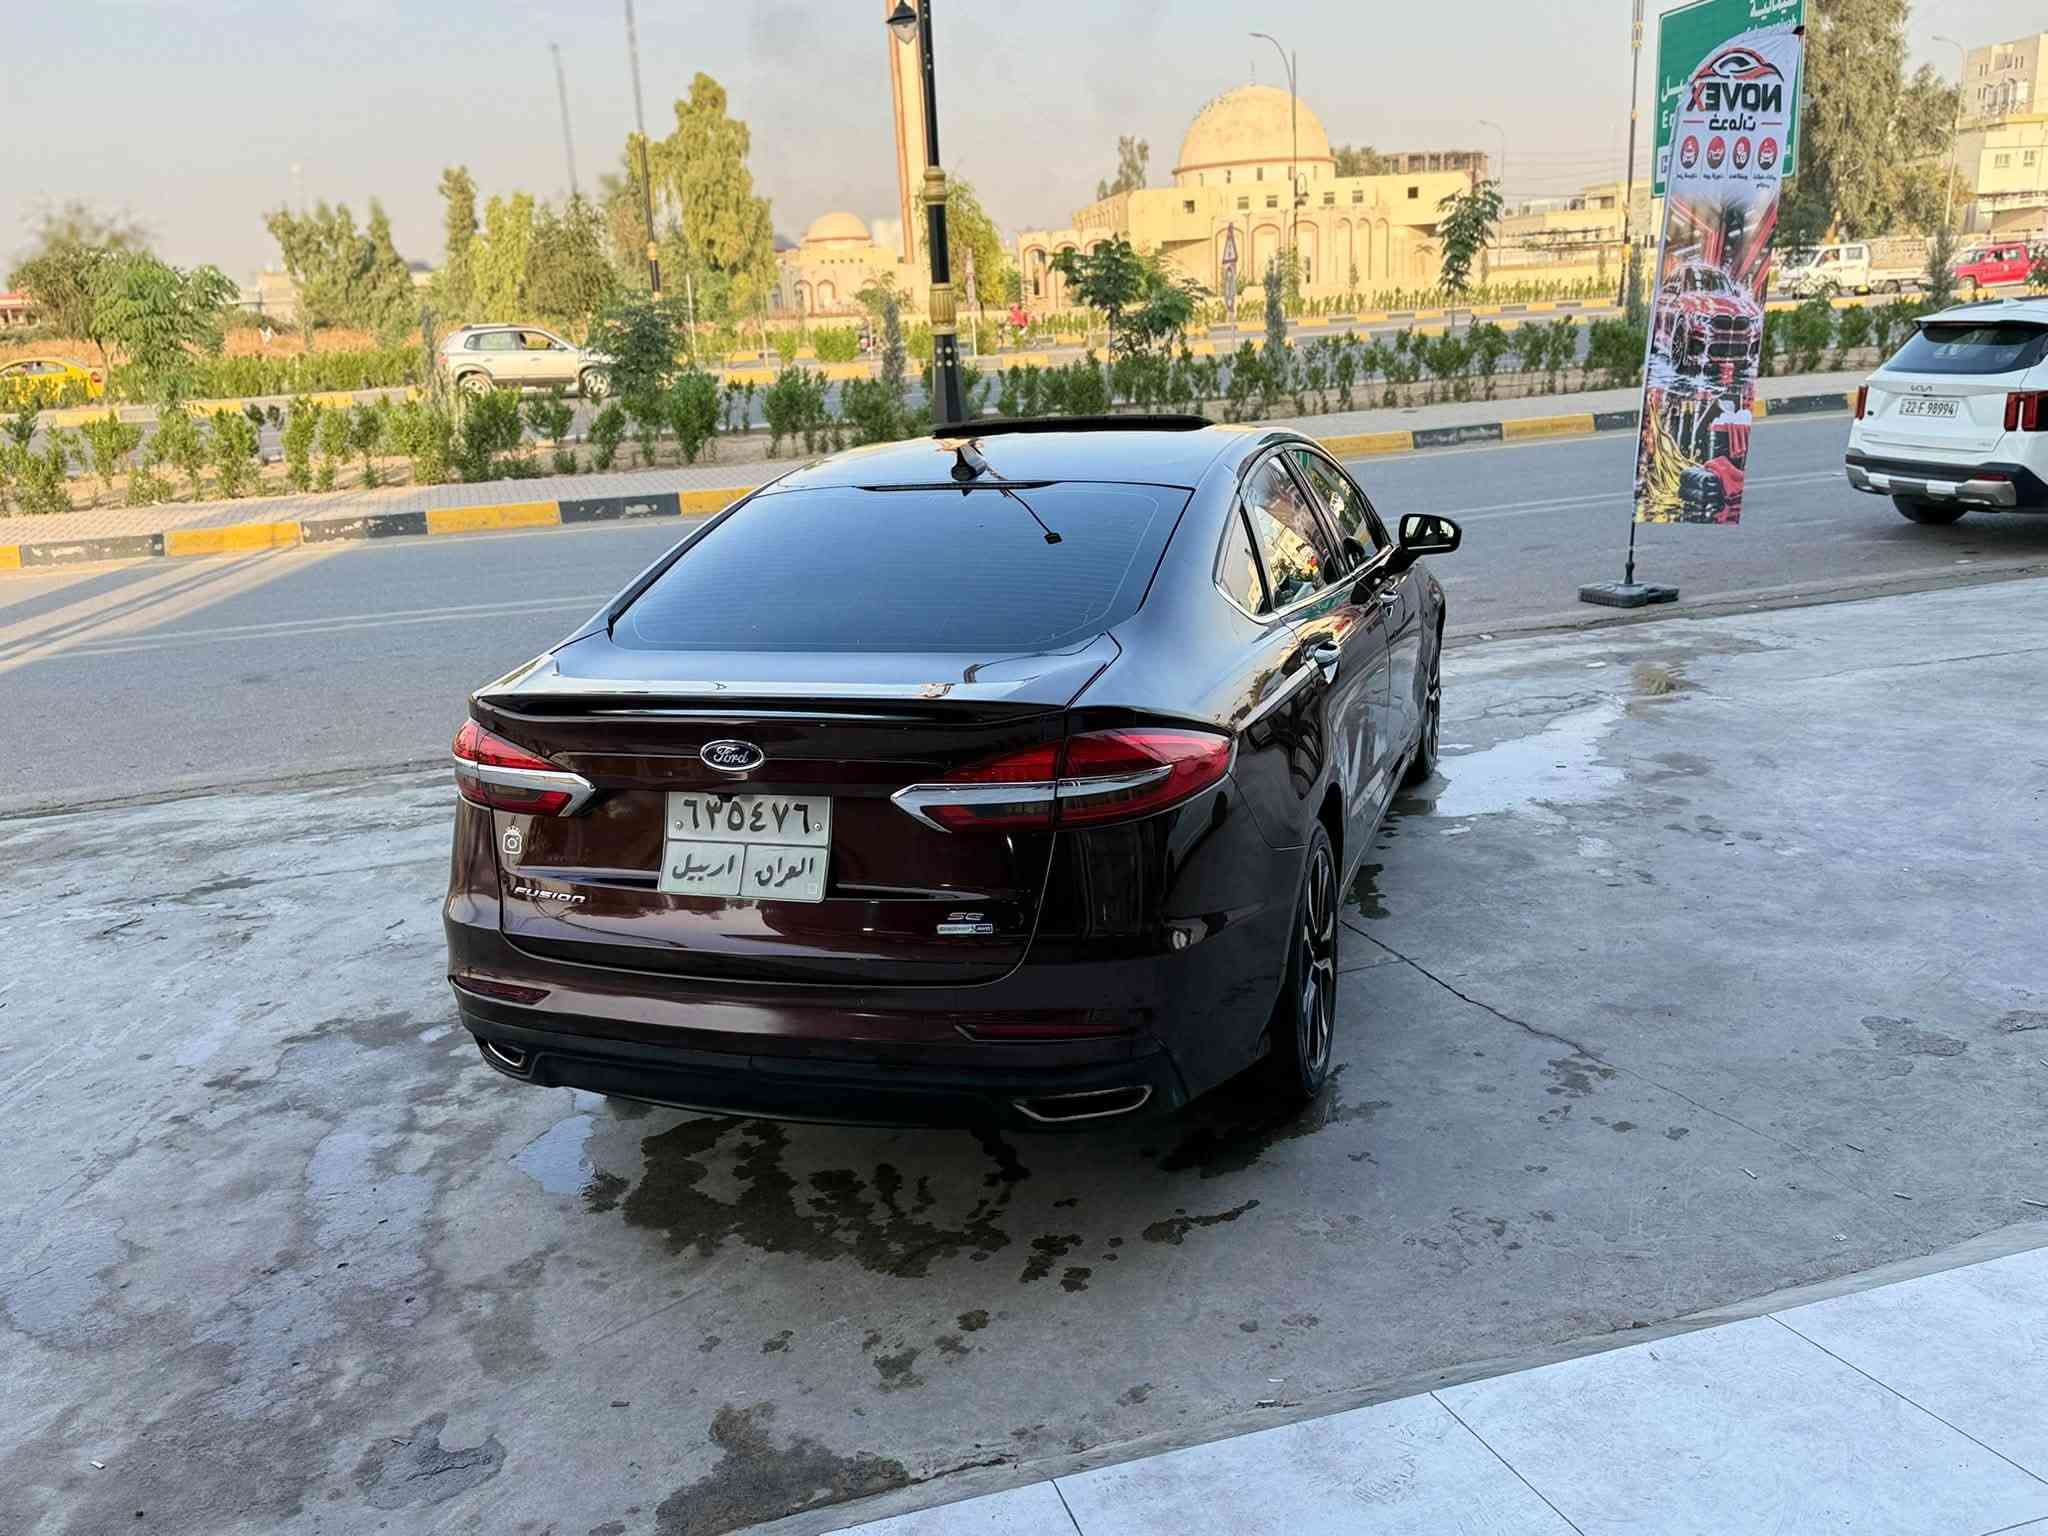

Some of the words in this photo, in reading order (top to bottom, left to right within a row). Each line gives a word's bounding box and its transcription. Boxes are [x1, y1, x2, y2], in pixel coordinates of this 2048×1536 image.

[1905, 401, 1917, 413] 22
[1918, 402, 1926, 414] F
[713, 745, 749, 764] Ford
[683, 799, 810, 834] ٦٣٥٤٧٦
[671, 853, 736, 881] اربيل
[754, 856, 815, 887] العراق
[513, 886, 586, 903] FUSION
